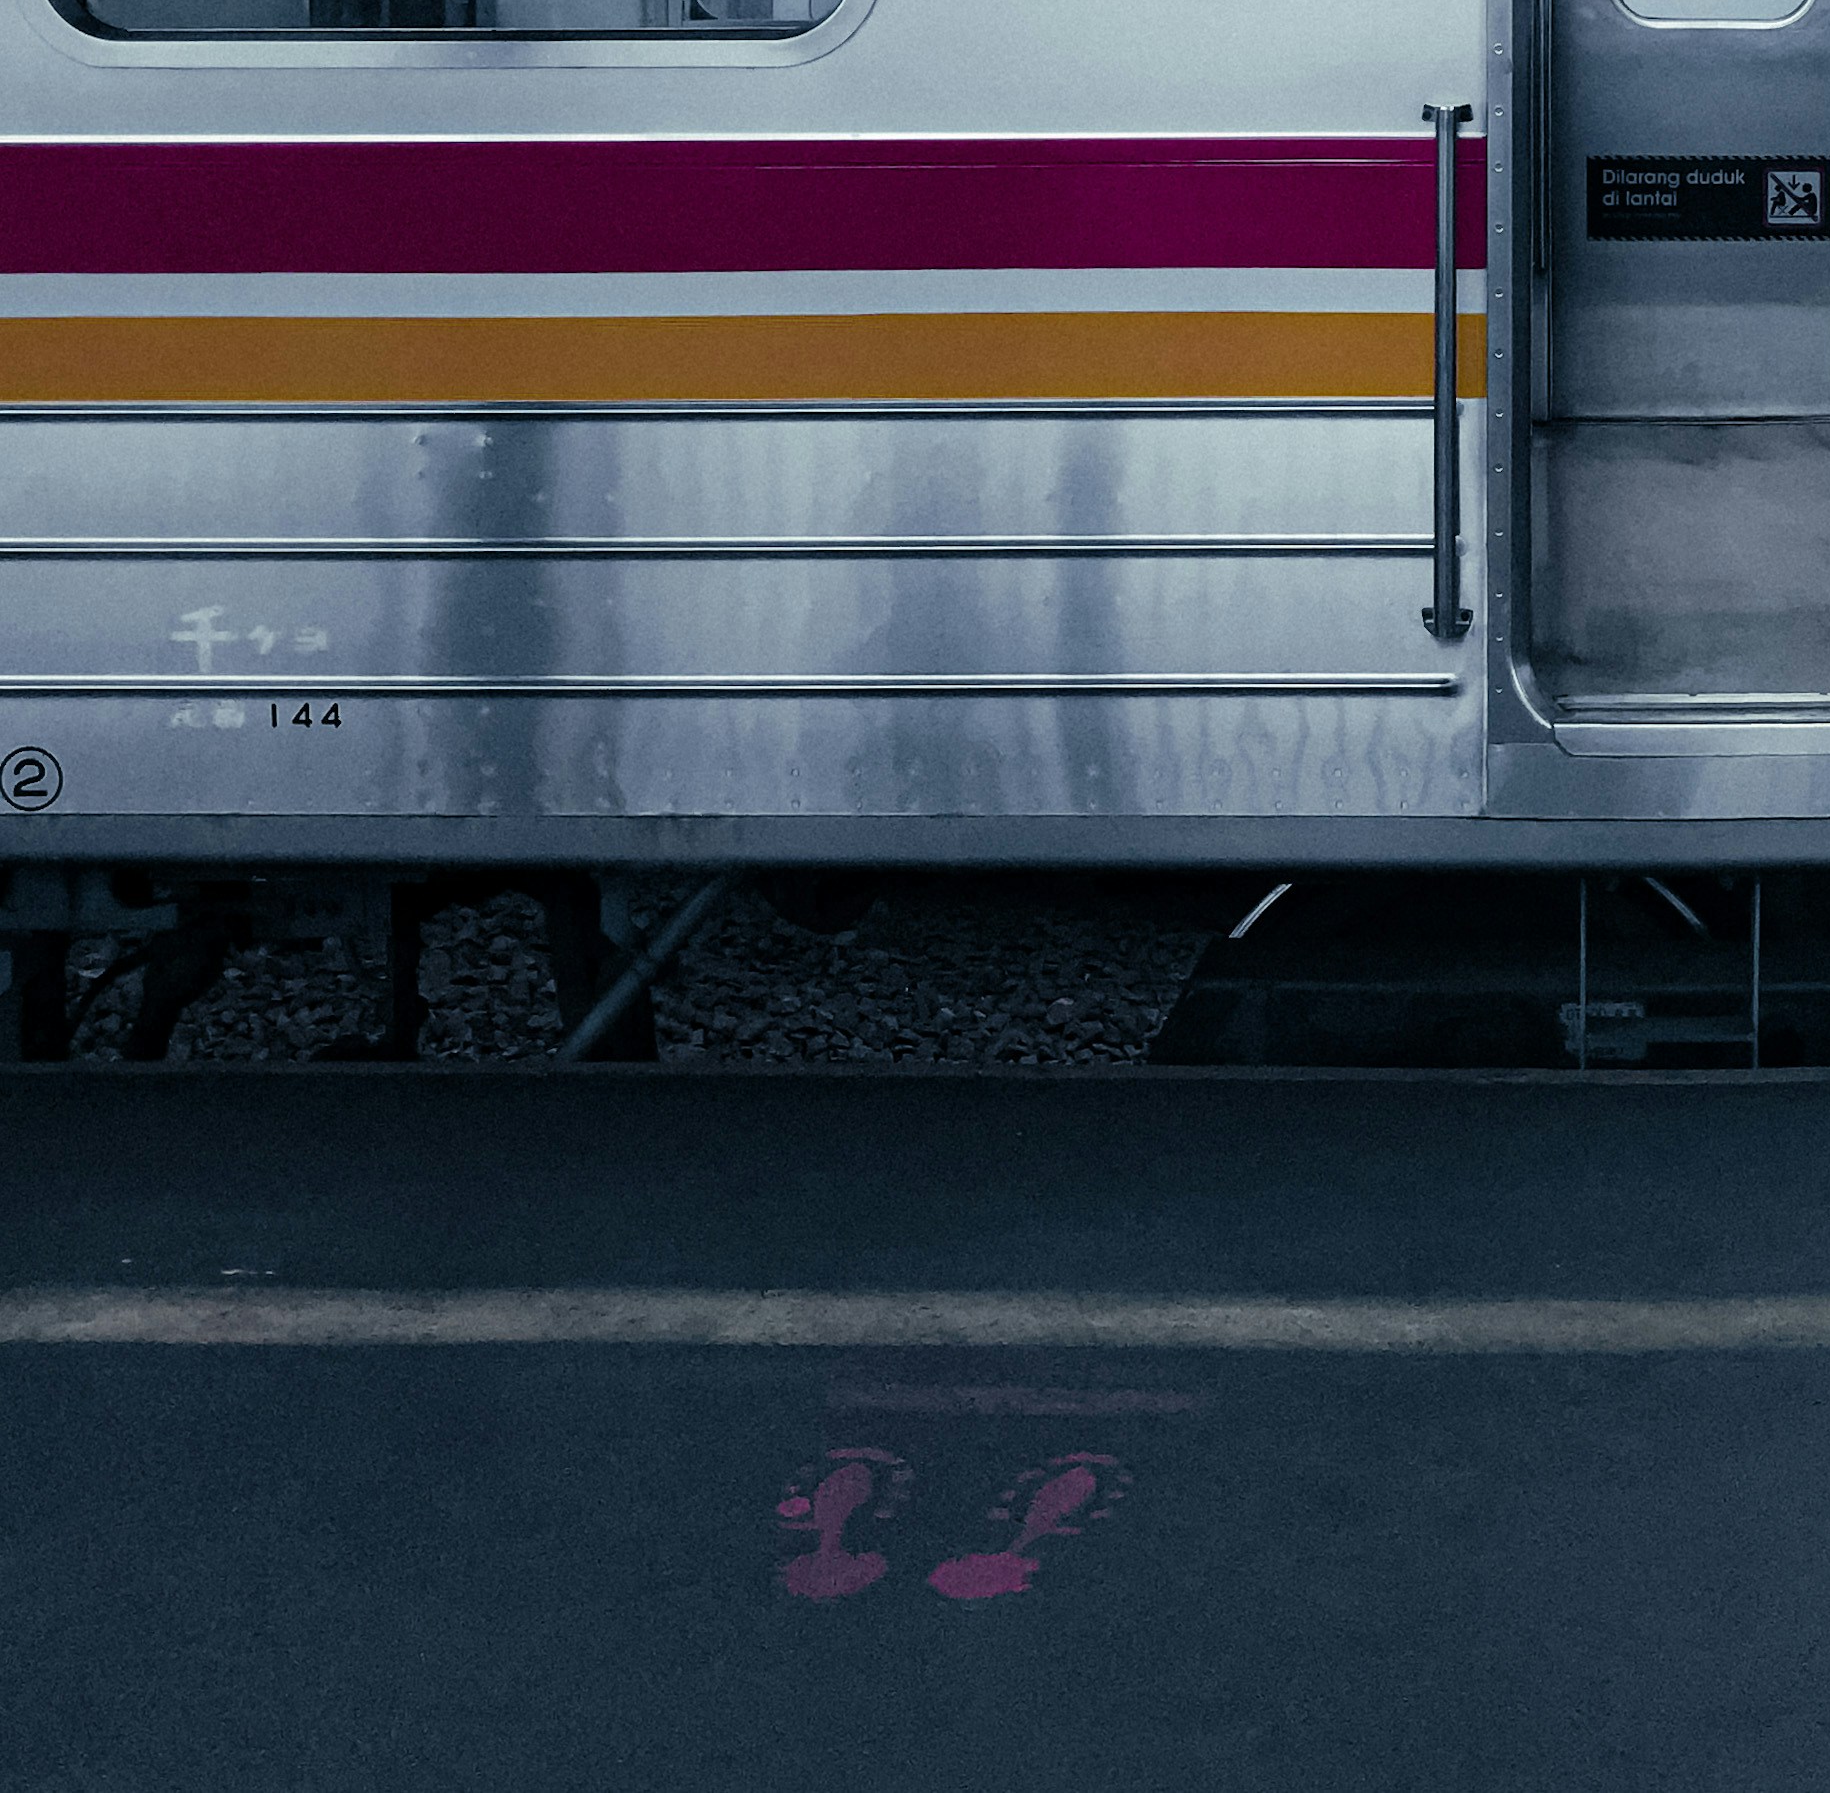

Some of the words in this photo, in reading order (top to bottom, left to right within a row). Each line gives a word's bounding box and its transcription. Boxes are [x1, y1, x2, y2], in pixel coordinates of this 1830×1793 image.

[1601, 168, 1681, 190] Dilarang
[1686, 167, 1746, 186] duduk
[1601, 189, 1622, 207] di
[1625, 189, 1678, 207] lantai
[270, 702, 343, 728] 144
